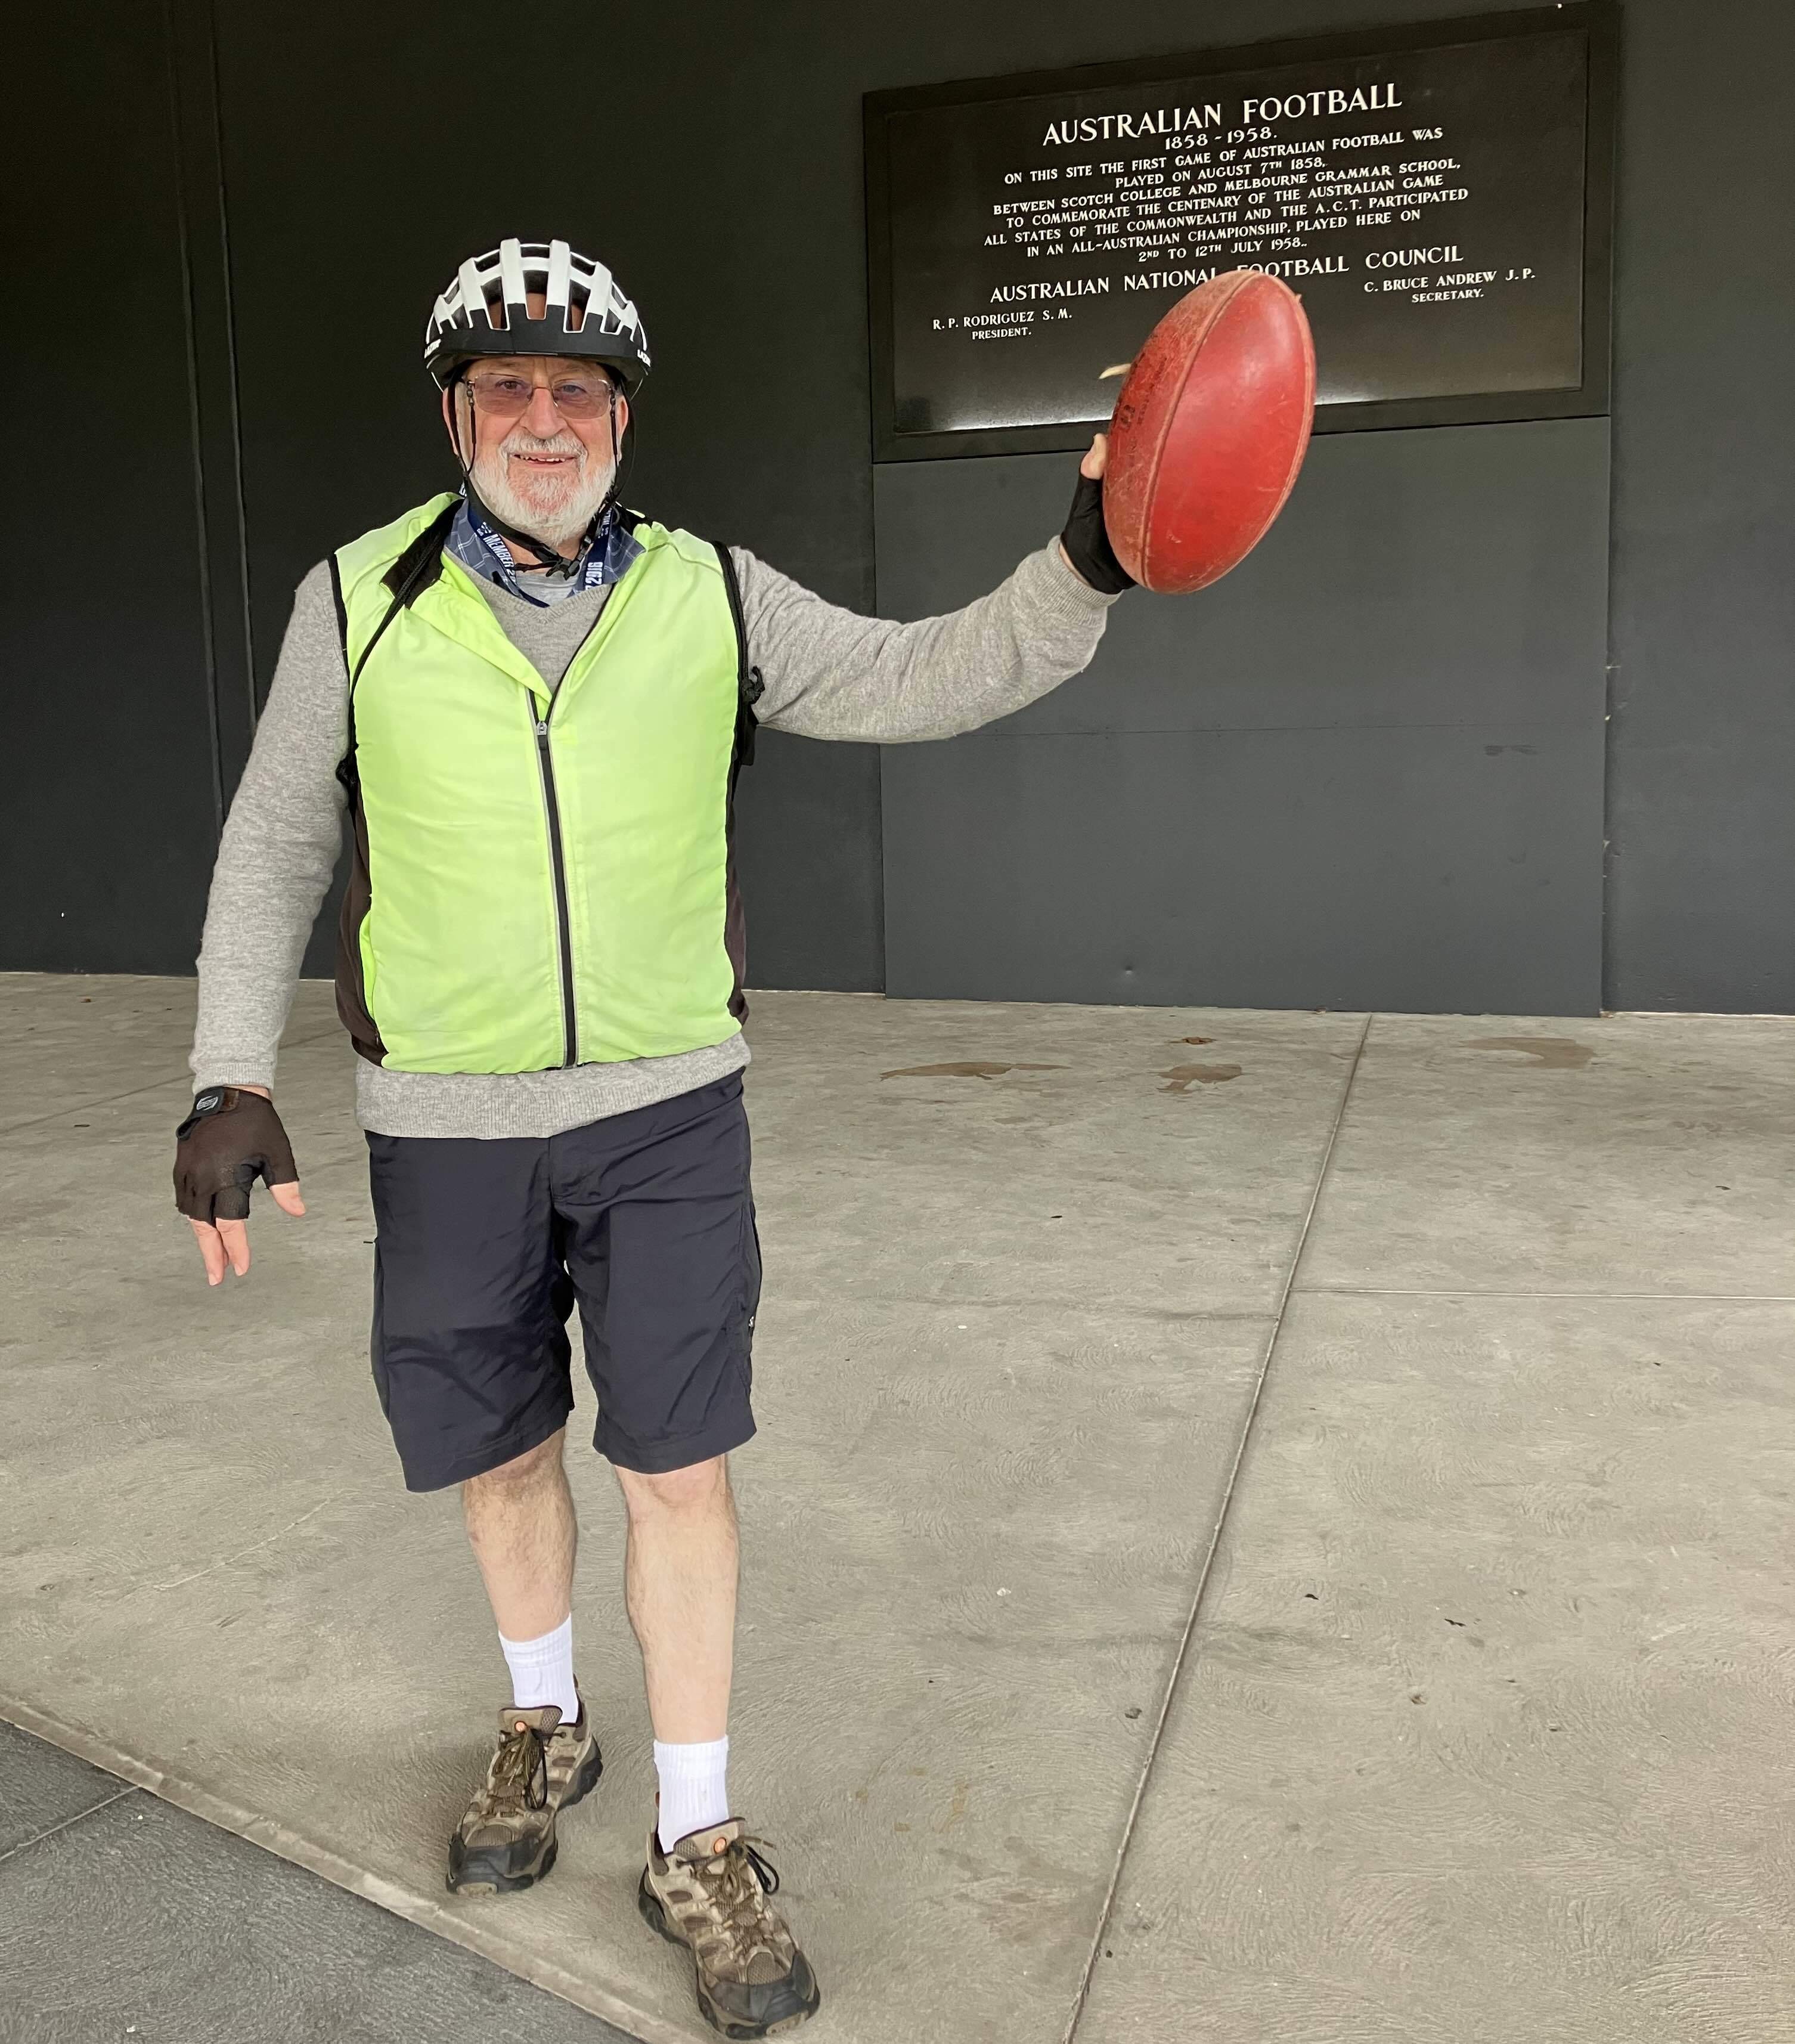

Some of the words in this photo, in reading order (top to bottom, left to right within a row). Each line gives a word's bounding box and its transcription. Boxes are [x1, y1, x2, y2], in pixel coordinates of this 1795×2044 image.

[1042, 103, 1221, 146] AUSTRALIAN
[1243, 83, 1403, 124] FOOTBALL
[1165, 133, 1208, 150] 1858
[1227, 126, 1278, 144] 1958.
[1004, 172, 1022, 185] ON
[1030, 168, 1058, 182] THIS
[1065, 165, 1093, 178] SITE
[1099, 161, 1124, 175] THE
[1131, 157, 1167, 172] FIRST
[1174, 152, 1212, 167] GAME
[1219, 149, 1237, 162] OF
[1242, 140, 1325, 160] AUSTRALIAN
[1332, 131, 1405, 150] FOOTBALL
[1412, 127, 1443, 141] WAS
[993, 199, 1055, 215] BETWEEN
[1061, 193, 1114, 208] SCOTCH
[1120, 186, 1181, 202] COLLEGE
[1188, 182, 1217, 196] AND
[1224, 173, 1308, 191] MELBOURNE
[1315, 165, 1393, 182] GRAMMAR
[1398, 158, 1461, 174] SCHOOL,
[1115, 173, 1164, 188] PLAYED
[1171, 169, 1191, 182] ON
[1197, 163, 1252, 180] AUGUST
[1006, 216, 1024, 229] TO
[1032, 206, 1131, 226] COMMEMORATE
[1135, 203, 1162, 216] THE
[1167, 194, 1242, 212] CENTENARY
[1248, 192, 1267, 205] OF
[1273, 188, 1301, 202] THE
[1307, 179, 1395, 199] AUSTRALIAN
[1402, 174, 1444, 189] GAME
[984, 233, 1007, 246] ALL
[1015, 228, 1061, 243] STATES
[1069, 225, 1087, 237] OF
[1094, 222, 1120, 236] THE
[1126, 210, 1237, 232] COMMONWEALTH
[1244, 208, 1272, 221] AND
[1280, 204, 1308, 217] THE
[1368, 188, 1469, 209] PARTICIPATED
[1027, 246, 1039, 258] IN
[1046, 243, 1064, 256] AN
[1071, 232, 1180, 253] ALL-AUSTRALIAN
[1296, 216, 1348, 232] PLAYED
[1356, 212, 1391, 226] HERE
[1400, 209, 1421, 222] ON
[1167, 247, 1187, 260] TO
[1230, 239, 1264, 253] JULY
[990, 277, 1109, 303] AUSTRALIAN
[1365, 245, 1464, 270] COUNCIL
[1382, 277, 1429, 292] BRUCE
[1436, 270, 1498, 287] ANDREW
[1411, 288, 1484, 303] SECRETARY.
[963, 311, 1035, 328] RODRIGUEZ
[972, 327, 1032, 340] PRESIDENT.
[483, 534, 514, 568] MEMBER
[585, 562, 603, 584] 2016
